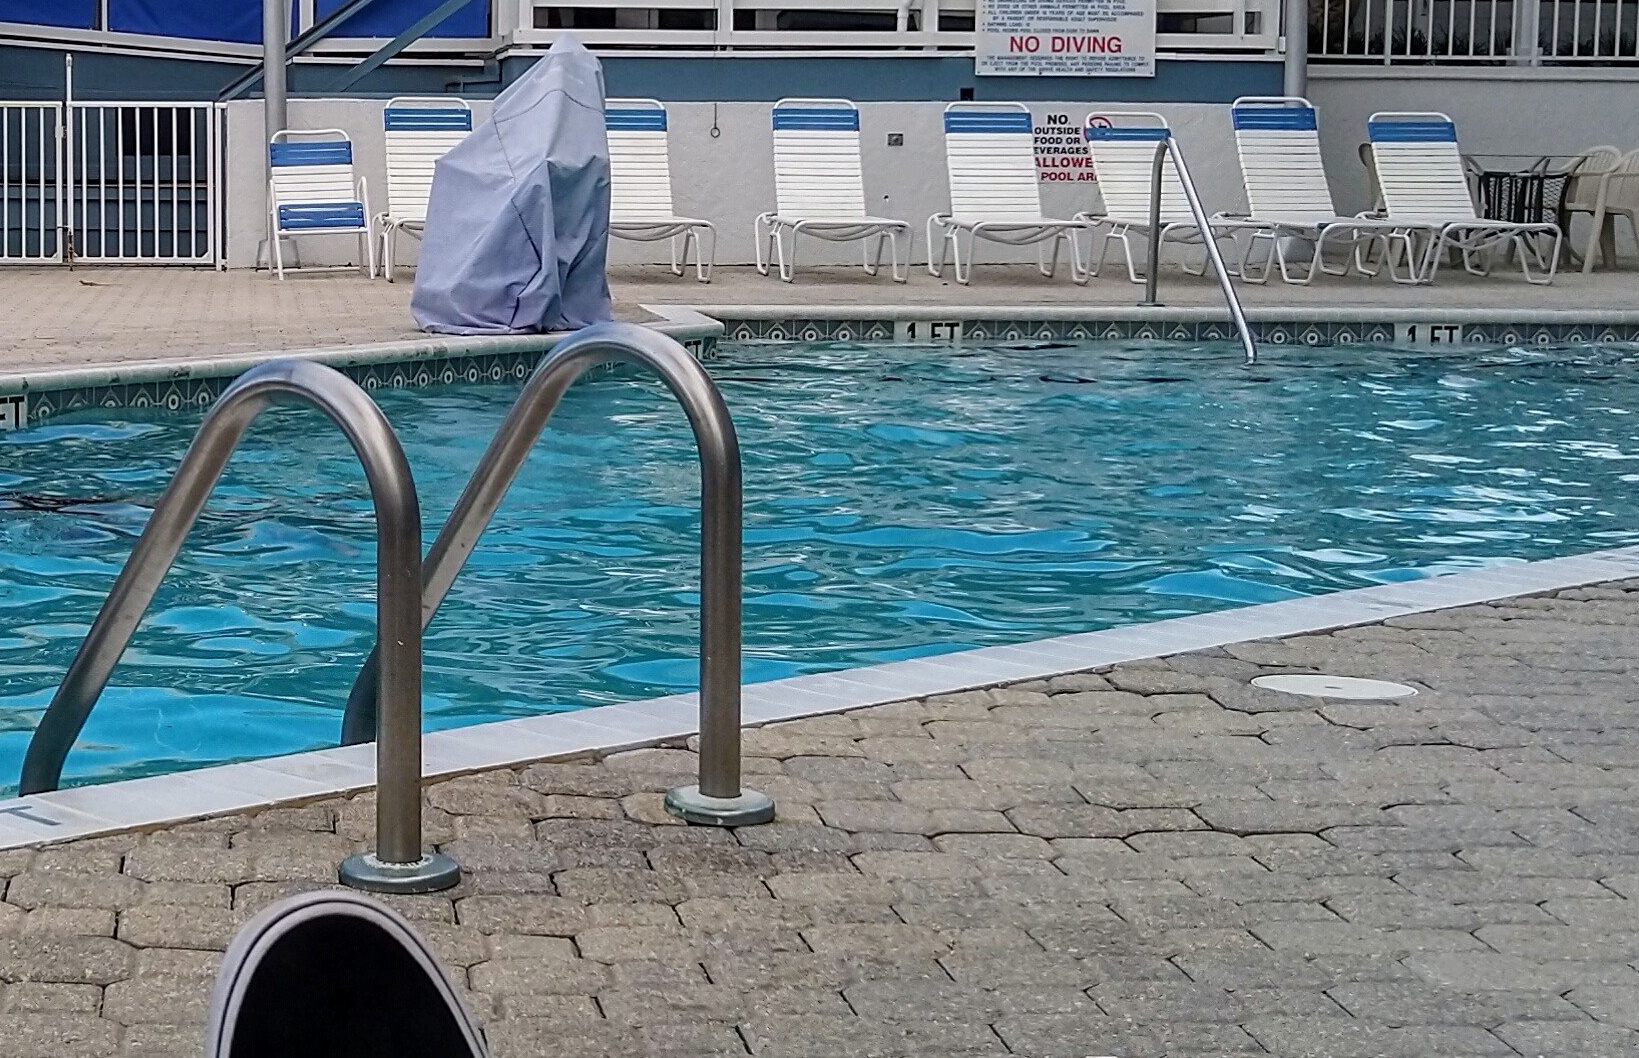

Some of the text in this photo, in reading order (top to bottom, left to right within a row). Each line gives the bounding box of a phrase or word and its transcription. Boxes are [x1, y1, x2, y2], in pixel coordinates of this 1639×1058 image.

[1010, 36, 1122, 53] NO DIVING
[1047, 114, 1068, 125] NO
[1034, 127, 1081, 135] OUTSIDE
[1034, 137, 1081, 145] FOOD OR
[1035, 157, 1093, 167] ALLOWE
[1041, 172, 1097, 181] POOL AR
[907, 322, 960, 342] 1 FT
[1407, 325, 1459, 343] 1 FT
